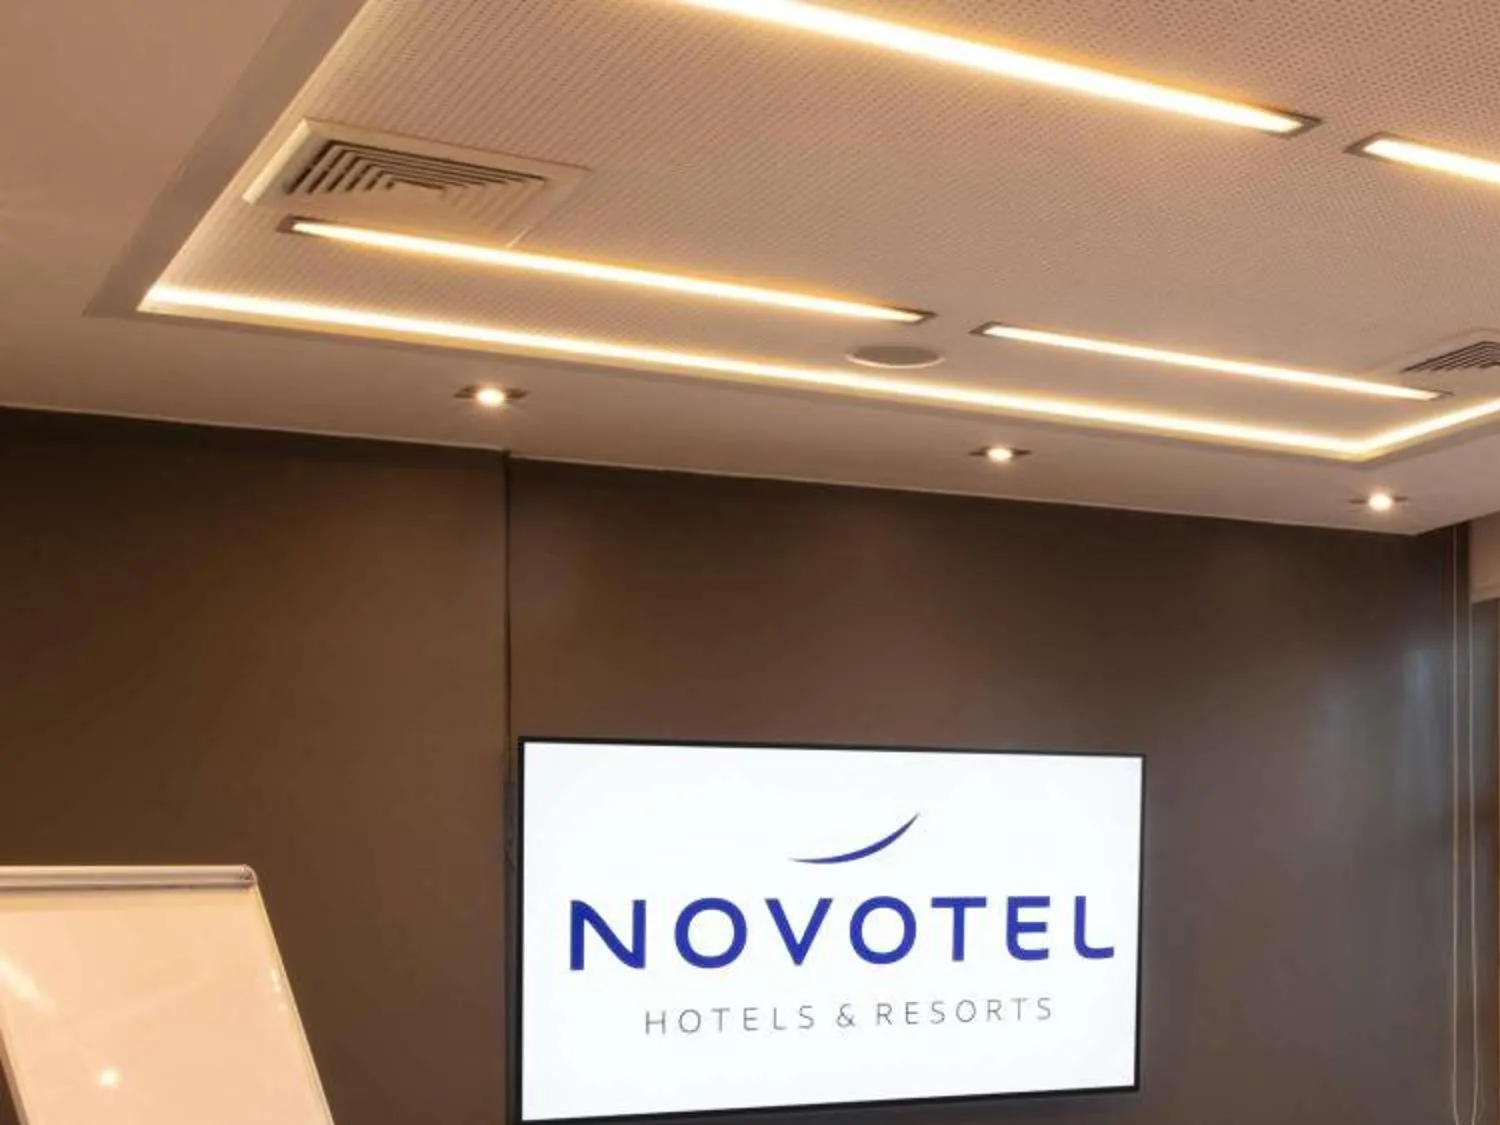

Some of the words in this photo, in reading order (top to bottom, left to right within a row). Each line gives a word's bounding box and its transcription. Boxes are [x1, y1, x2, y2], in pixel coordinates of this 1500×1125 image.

[569, 895, 1115, 972] NOVOTEL
[645, 1004, 815, 1036] HOTELS
[836, 1002, 856, 1029] &
[875, 997, 1053, 1027] RESORTS
